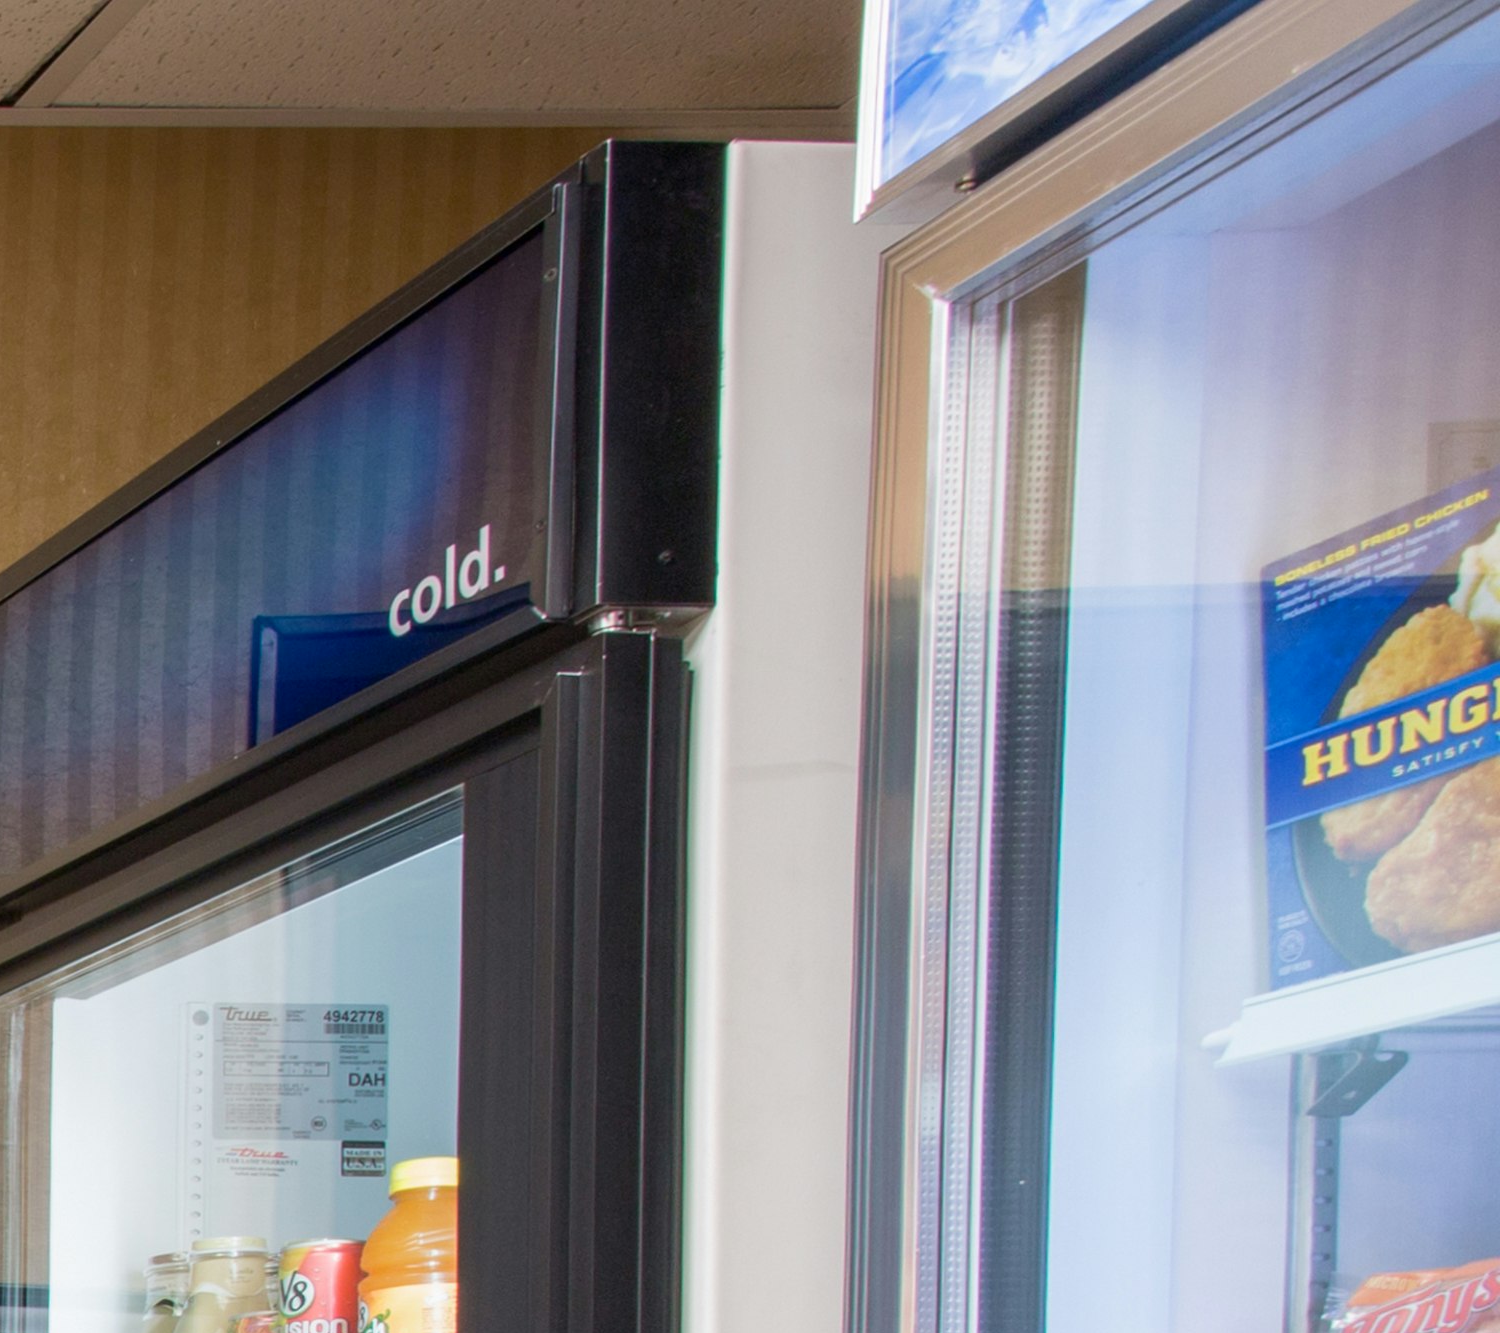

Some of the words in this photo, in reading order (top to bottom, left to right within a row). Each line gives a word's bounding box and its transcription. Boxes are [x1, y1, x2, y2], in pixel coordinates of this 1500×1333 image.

[1275, 545, 1357, 586] BONELESS
[1360, 523, 1411, 551] FRIED
[1414, 489, 1490, 529] CHICKEN
[388, 523, 506, 637] cold.
[1392, 736, 1485, 778] SATISFY
[220, 1005, 273, 1022] true
[323, 1009, 385, 1024] 4942778
[348, 1072, 386, 1087] DAH
